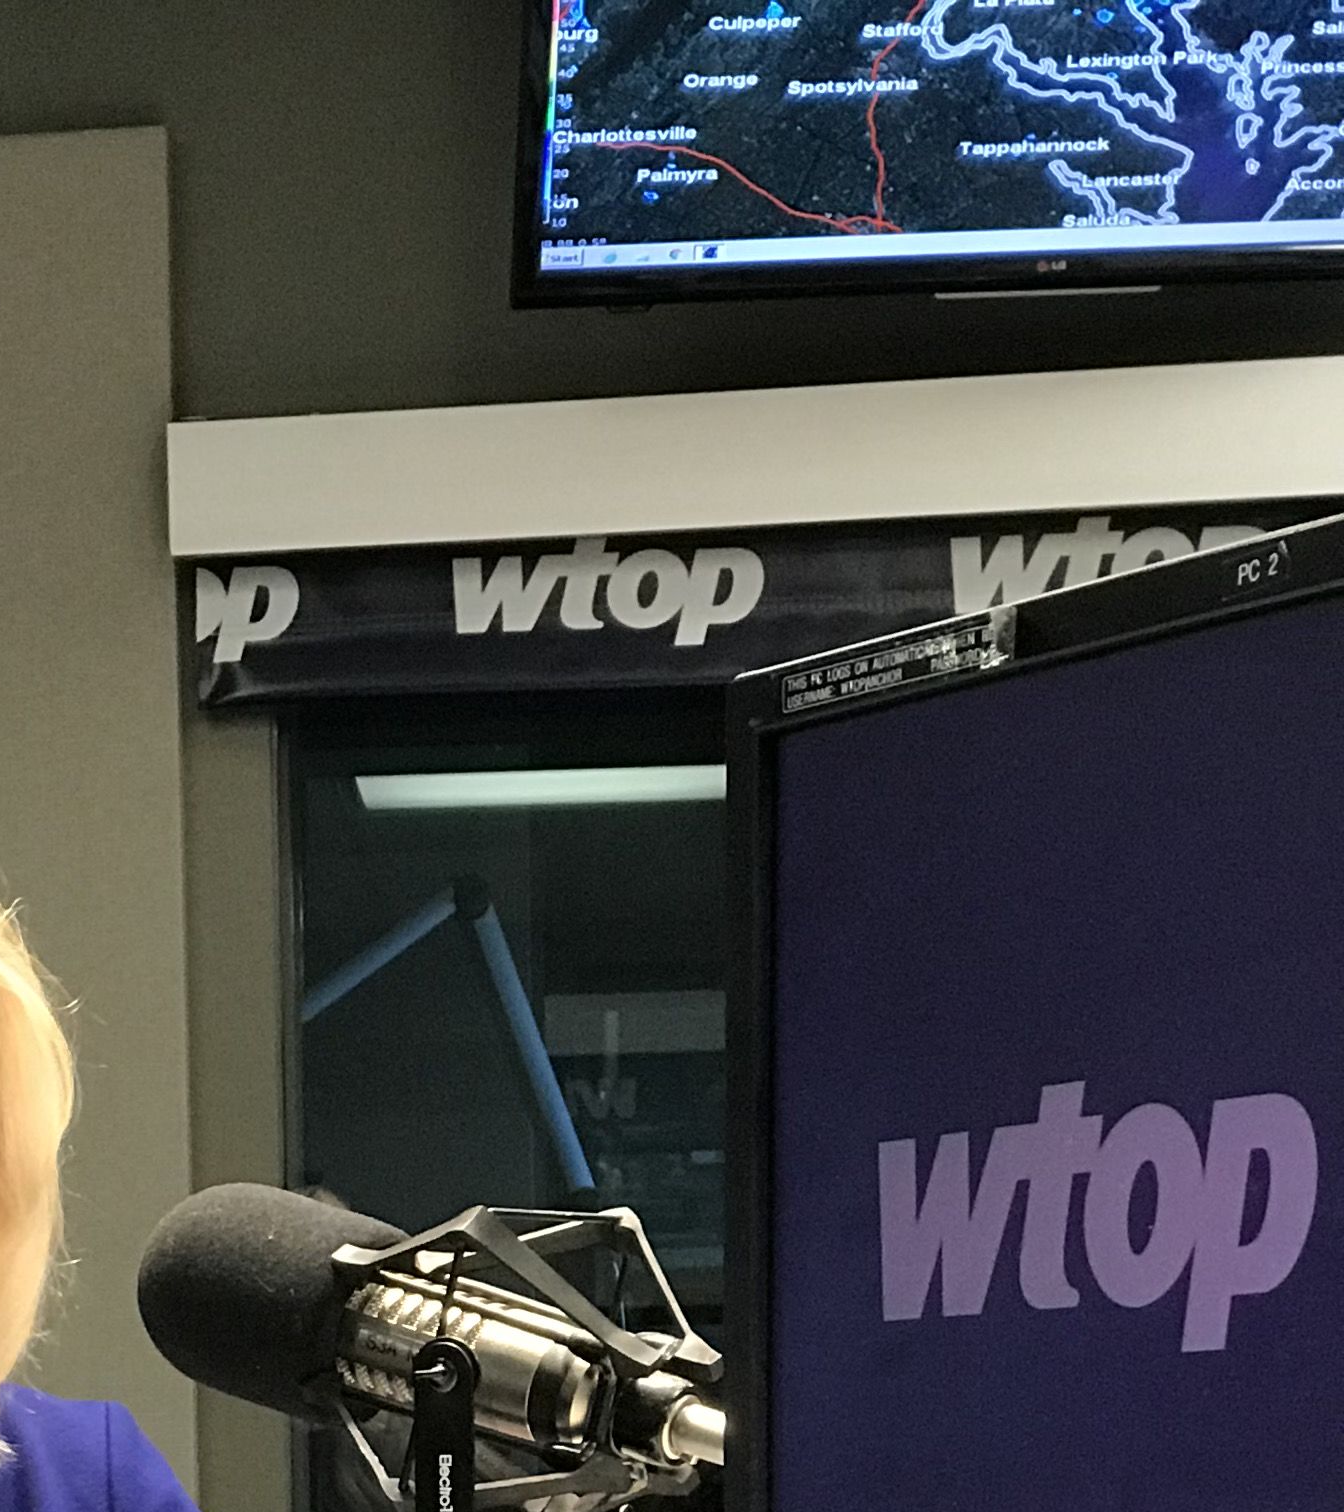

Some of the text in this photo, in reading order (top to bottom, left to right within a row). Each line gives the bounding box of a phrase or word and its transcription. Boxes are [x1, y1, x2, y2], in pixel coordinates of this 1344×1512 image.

[708, 15, 802, 32] Culpeper
[862, 22, 945, 38] Stafford
[1066, 51, 1218, 69] Lexington Park
[683, 74, 759, 90] Orange
[787, 77, 919, 96] Spotsylvania
[552, 126, 697, 144] Charlottesville
[959, 137, 1110, 157] Tappahannock
[637, 168, 719, 184] Palmyra
[1081, 172, 1180, 188] Lancaster
[1062, 214, 1131, 227] Saluda
[1237, 552, 1279, 586] PC 2
[452, 536, 765, 646] wtop
[787, 674, 807, 692] THIS
[810, 669, 823, 686] PC
[878, 1080, 1318, 1353] wtop
